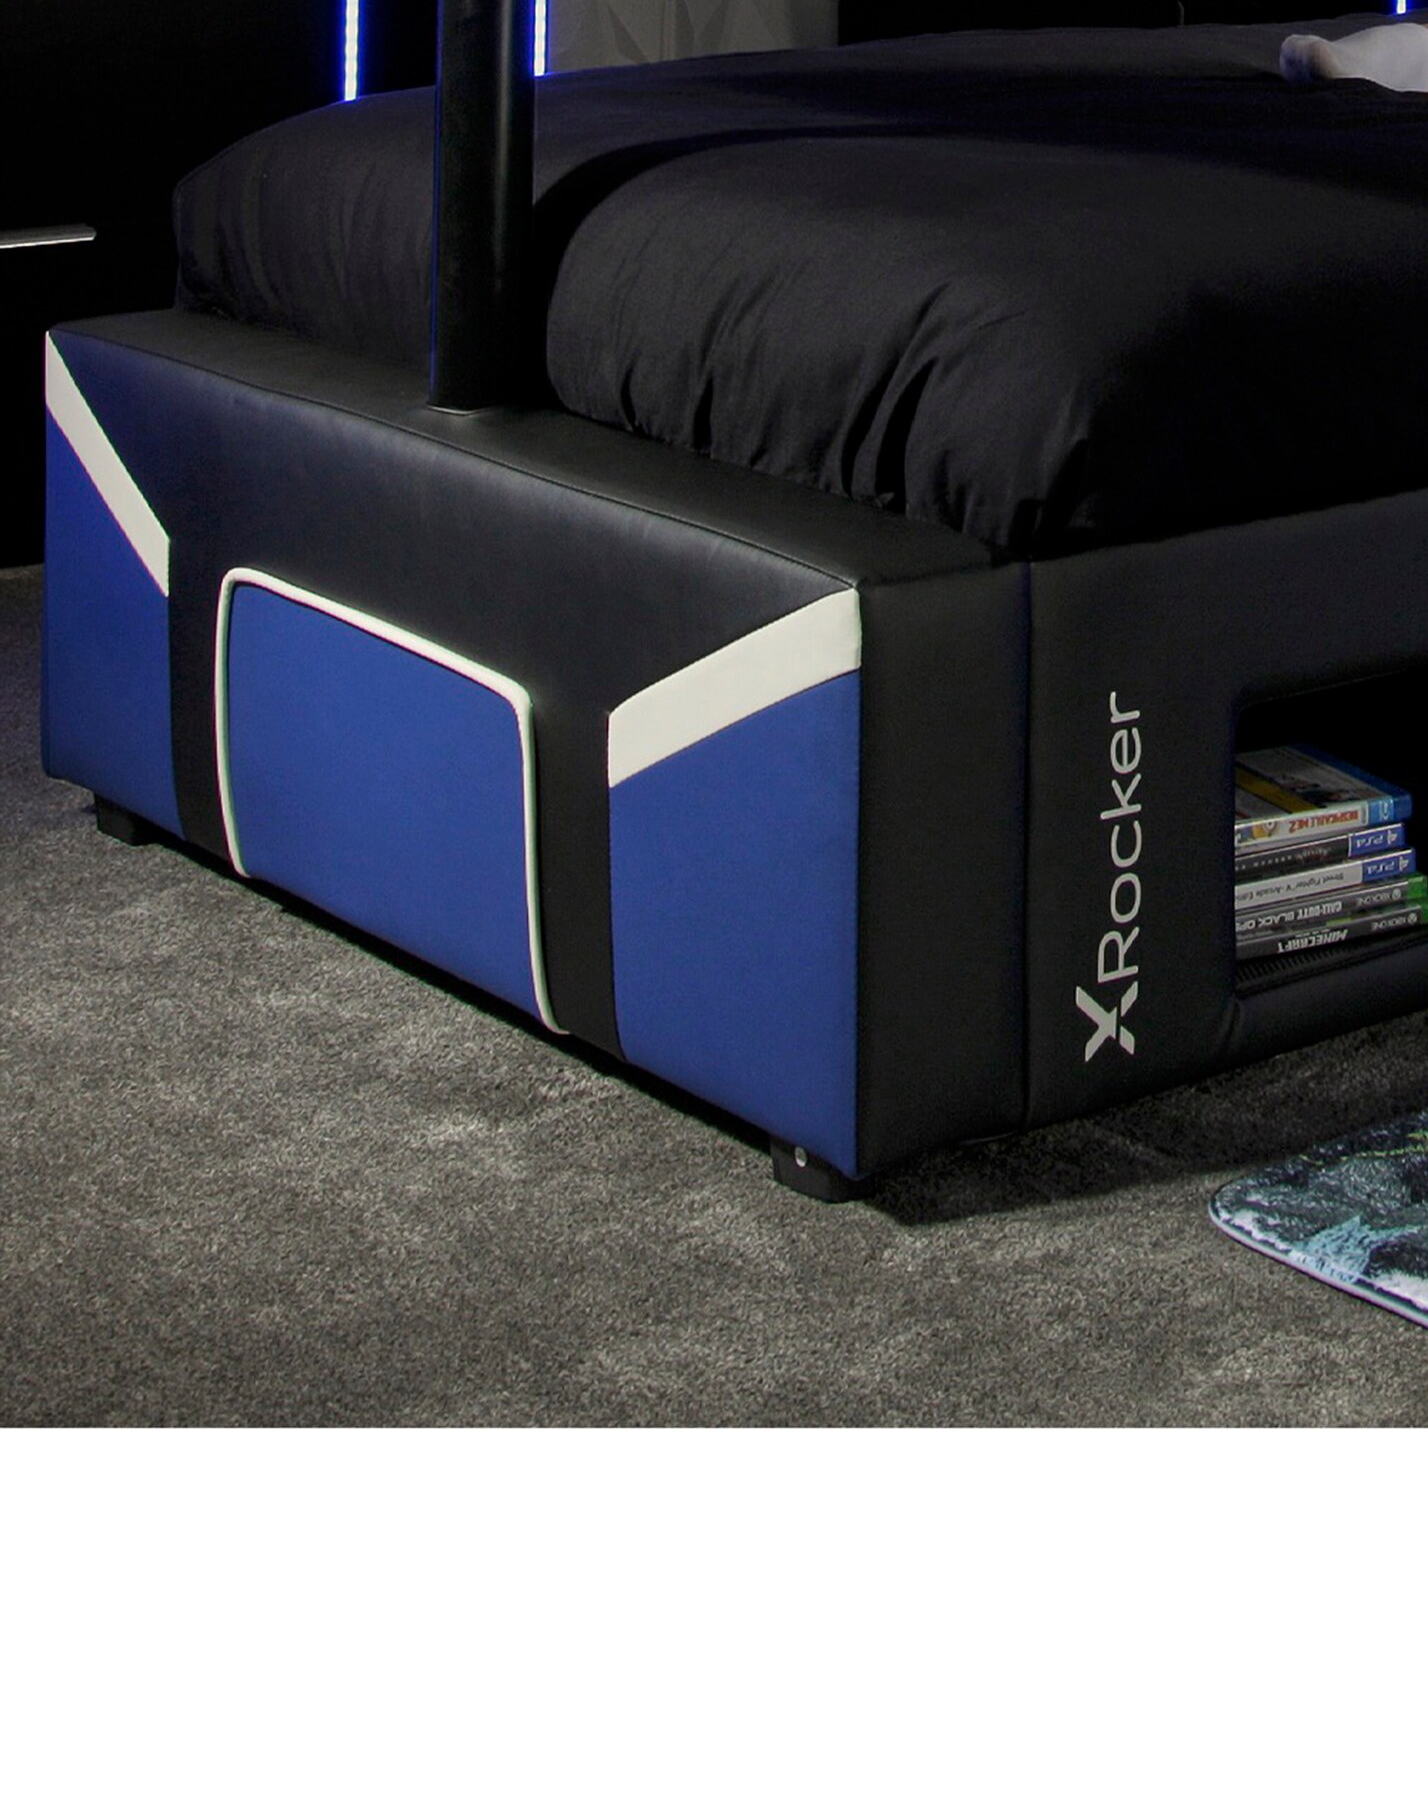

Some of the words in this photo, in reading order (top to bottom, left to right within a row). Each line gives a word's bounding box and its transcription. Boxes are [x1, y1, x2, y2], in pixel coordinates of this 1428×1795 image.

[1322, 872, 1344, 883] Street
[1321, 901, 1343, 914] CALL
[1258, 910, 1294, 926] BLACK
[1277, 929, 1349, 954] MINECRAFT
